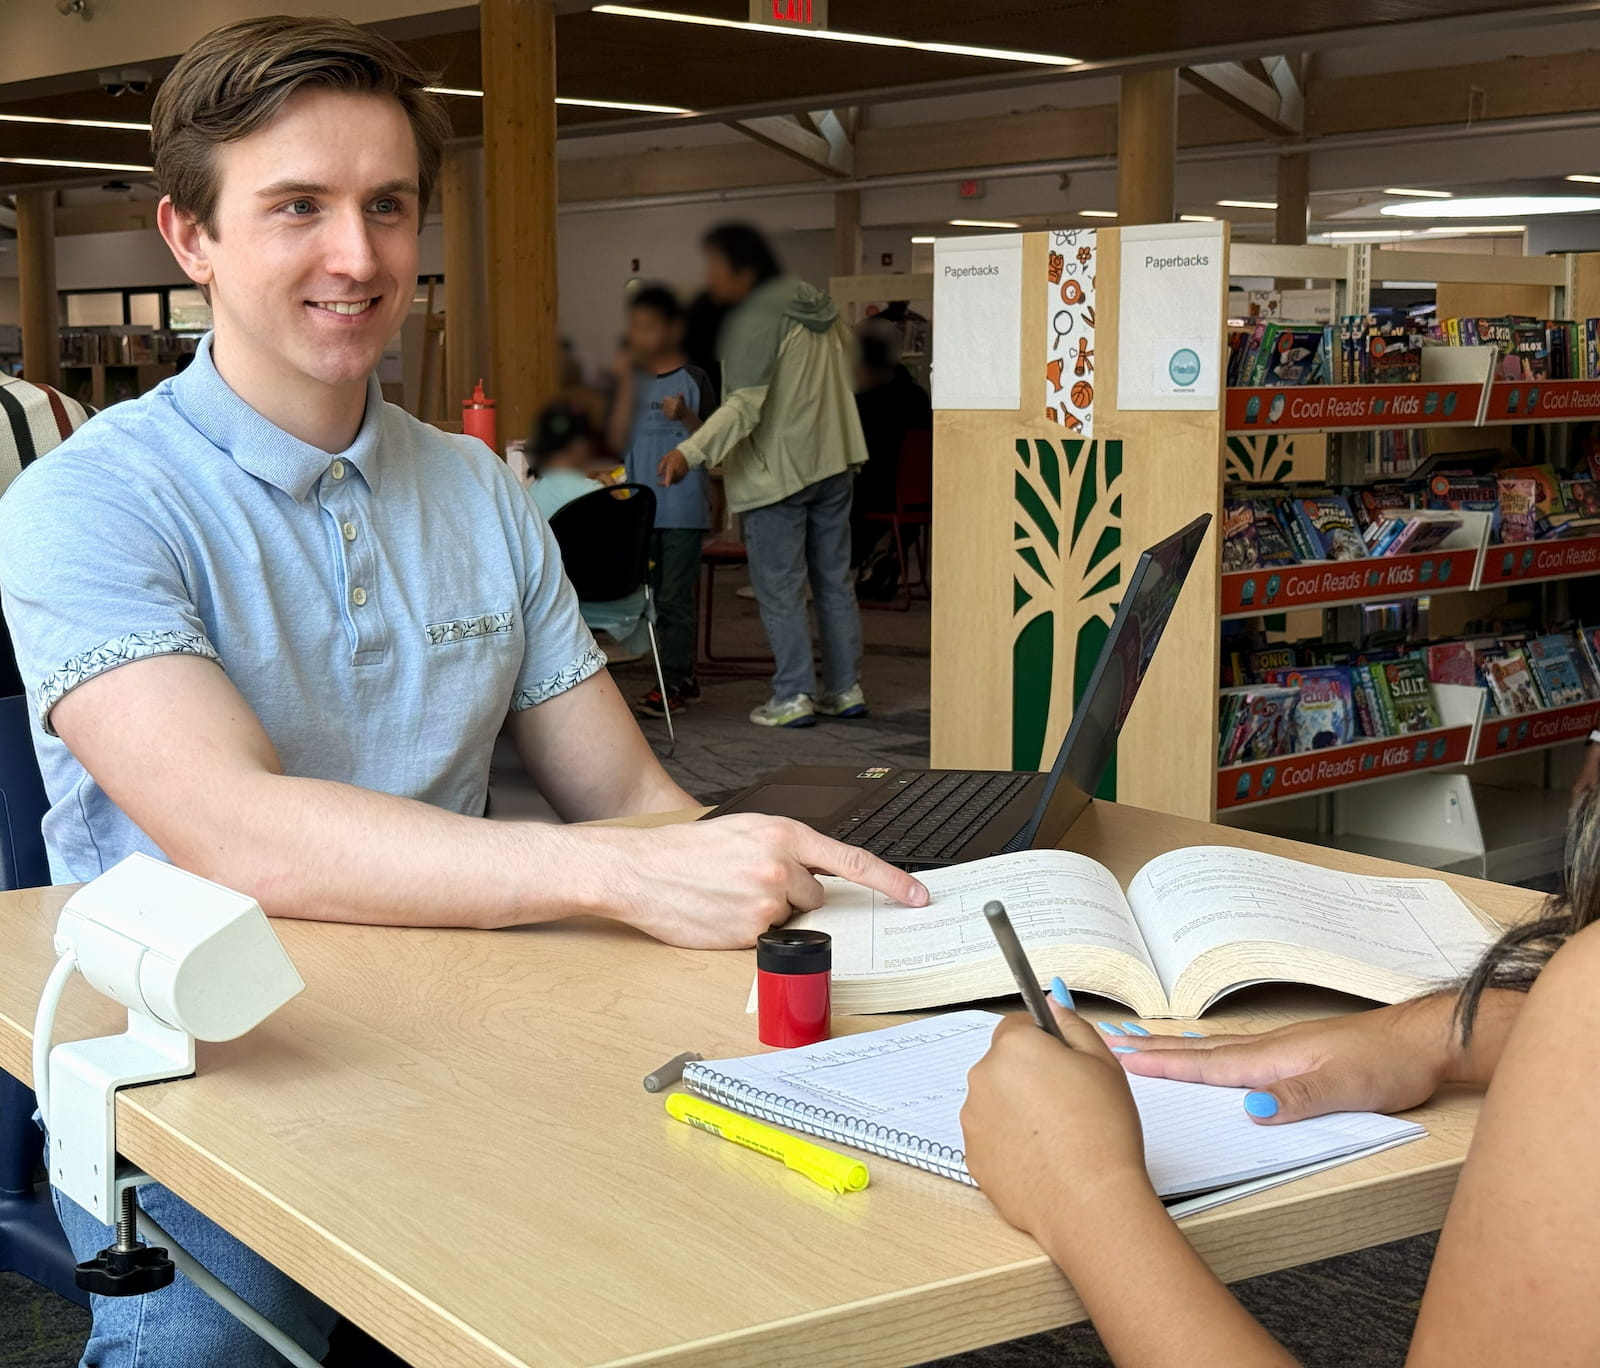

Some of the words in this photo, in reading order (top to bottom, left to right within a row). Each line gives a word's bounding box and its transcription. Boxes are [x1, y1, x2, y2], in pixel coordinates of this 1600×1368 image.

[944, 264, 1000, 280] Paperbacks
[1144, 254, 1209, 271] Paperbacks
[1290, 397, 1325, 418] Cool
[1326, 395, 1366, 417] Reads
[1391, 394, 1420, 414] Kids
[1542, 390, 1570, 410] Cool
[1570, 388, 1600, 409] Reads
[1537, 547, 1565, 569] Cool
[1565, 545, 1597, 566] Reads
[1286, 574, 1319, 597] Cool
[1321, 571, 1360, 593] Reads
[1386, 564, 1415, 585] Kids
[1258, 652, 1289, 669] ONIC
[1532, 715, 1560, 739] Cool
[1560, 711, 1593, 734] Reads
[1281, 763, 1315, 787] Cool
[1316, 755, 1356, 780] Reads
[1381, 746, 1409, 768] Kids
